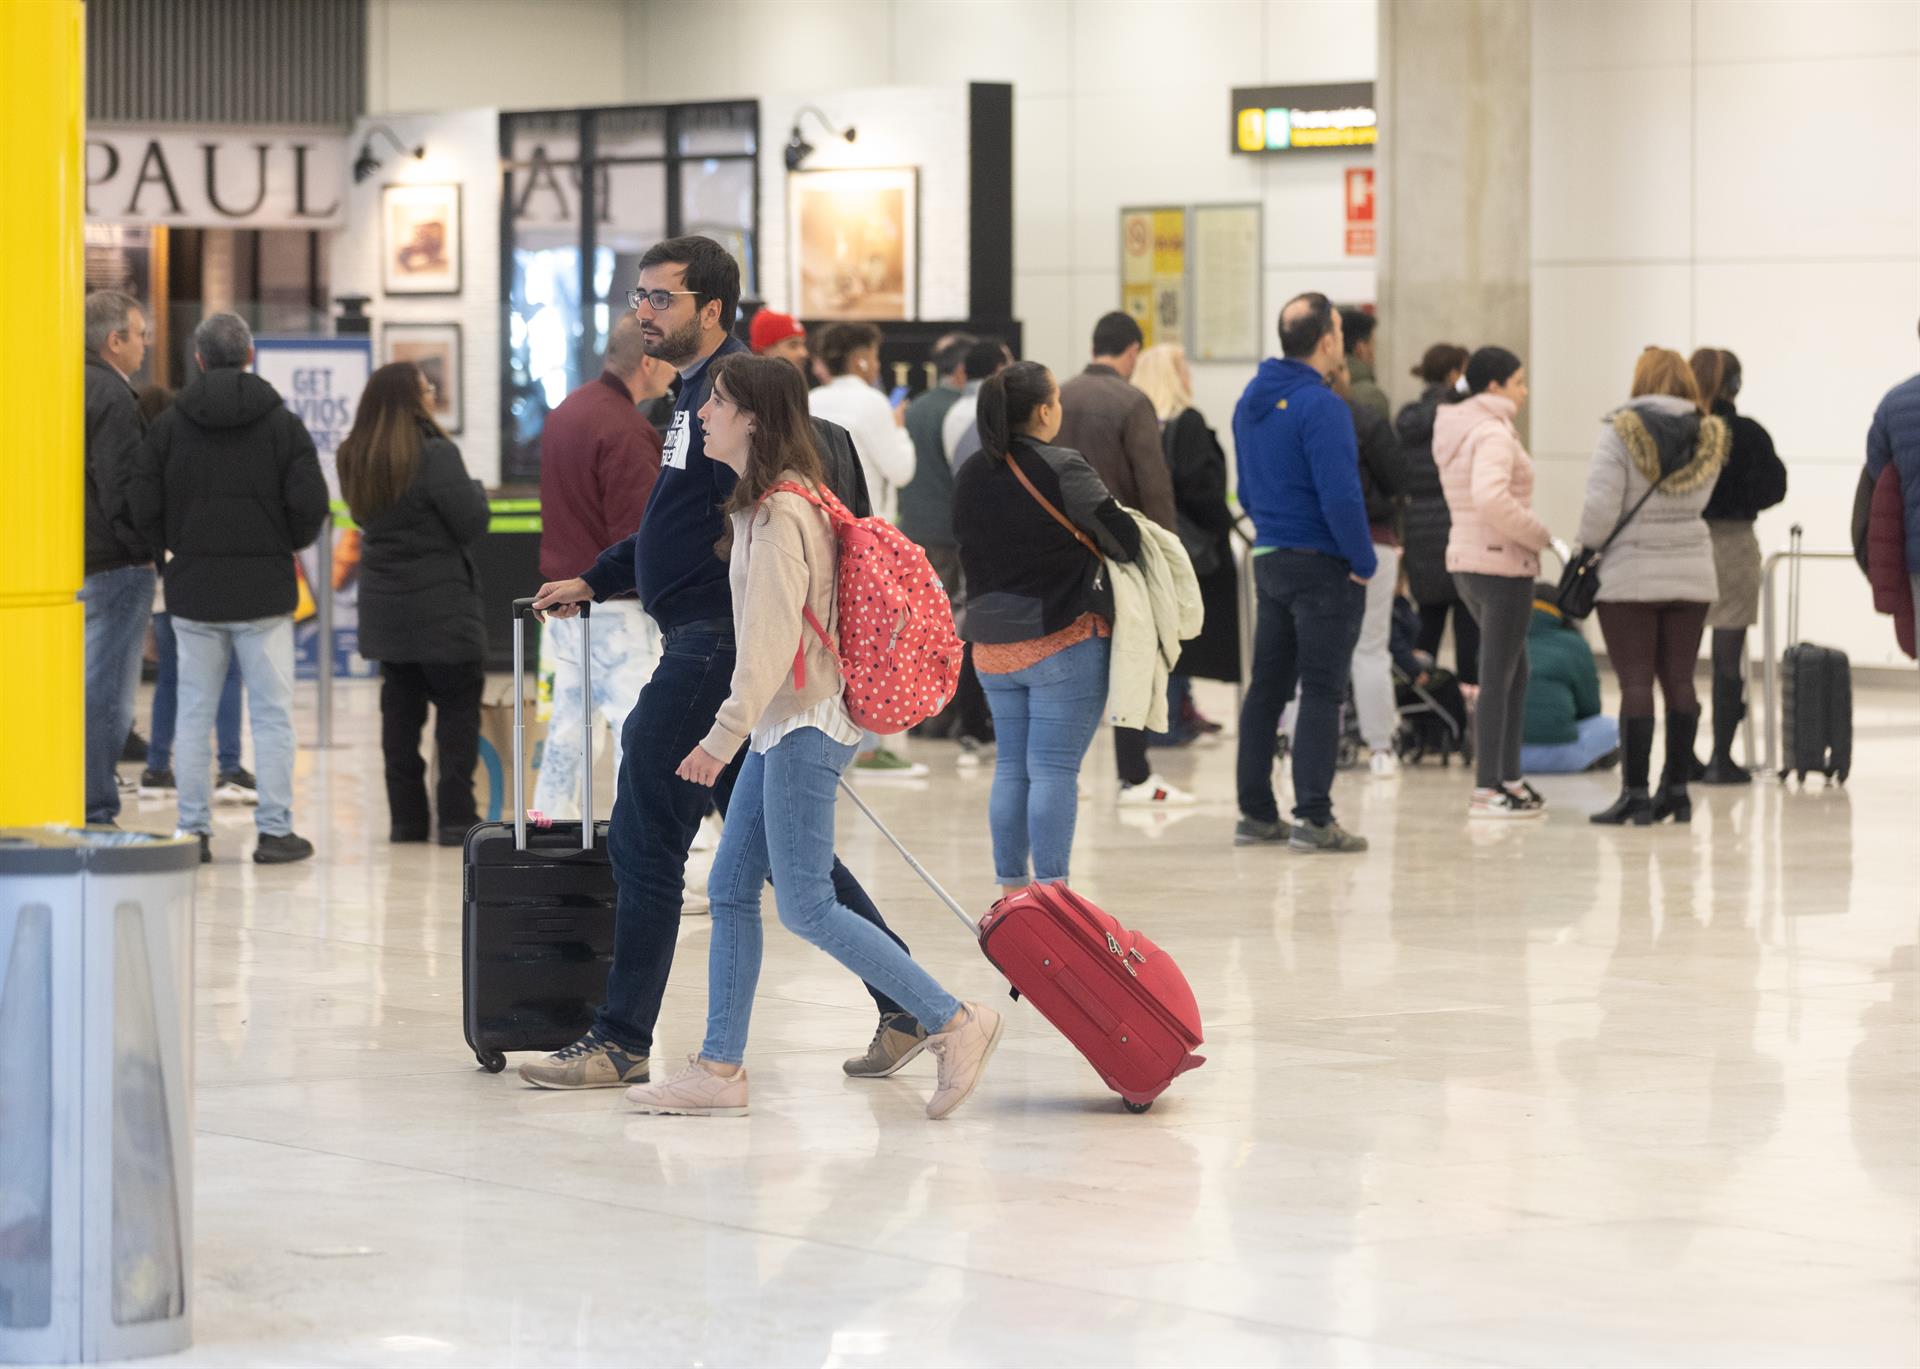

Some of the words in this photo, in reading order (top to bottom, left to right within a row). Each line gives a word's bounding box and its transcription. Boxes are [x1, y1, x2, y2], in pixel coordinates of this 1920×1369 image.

[85, 138, 340, 219] PAUL
[292, 368, 332, 396] GET
[284, 396, 350, 427] VIOS
